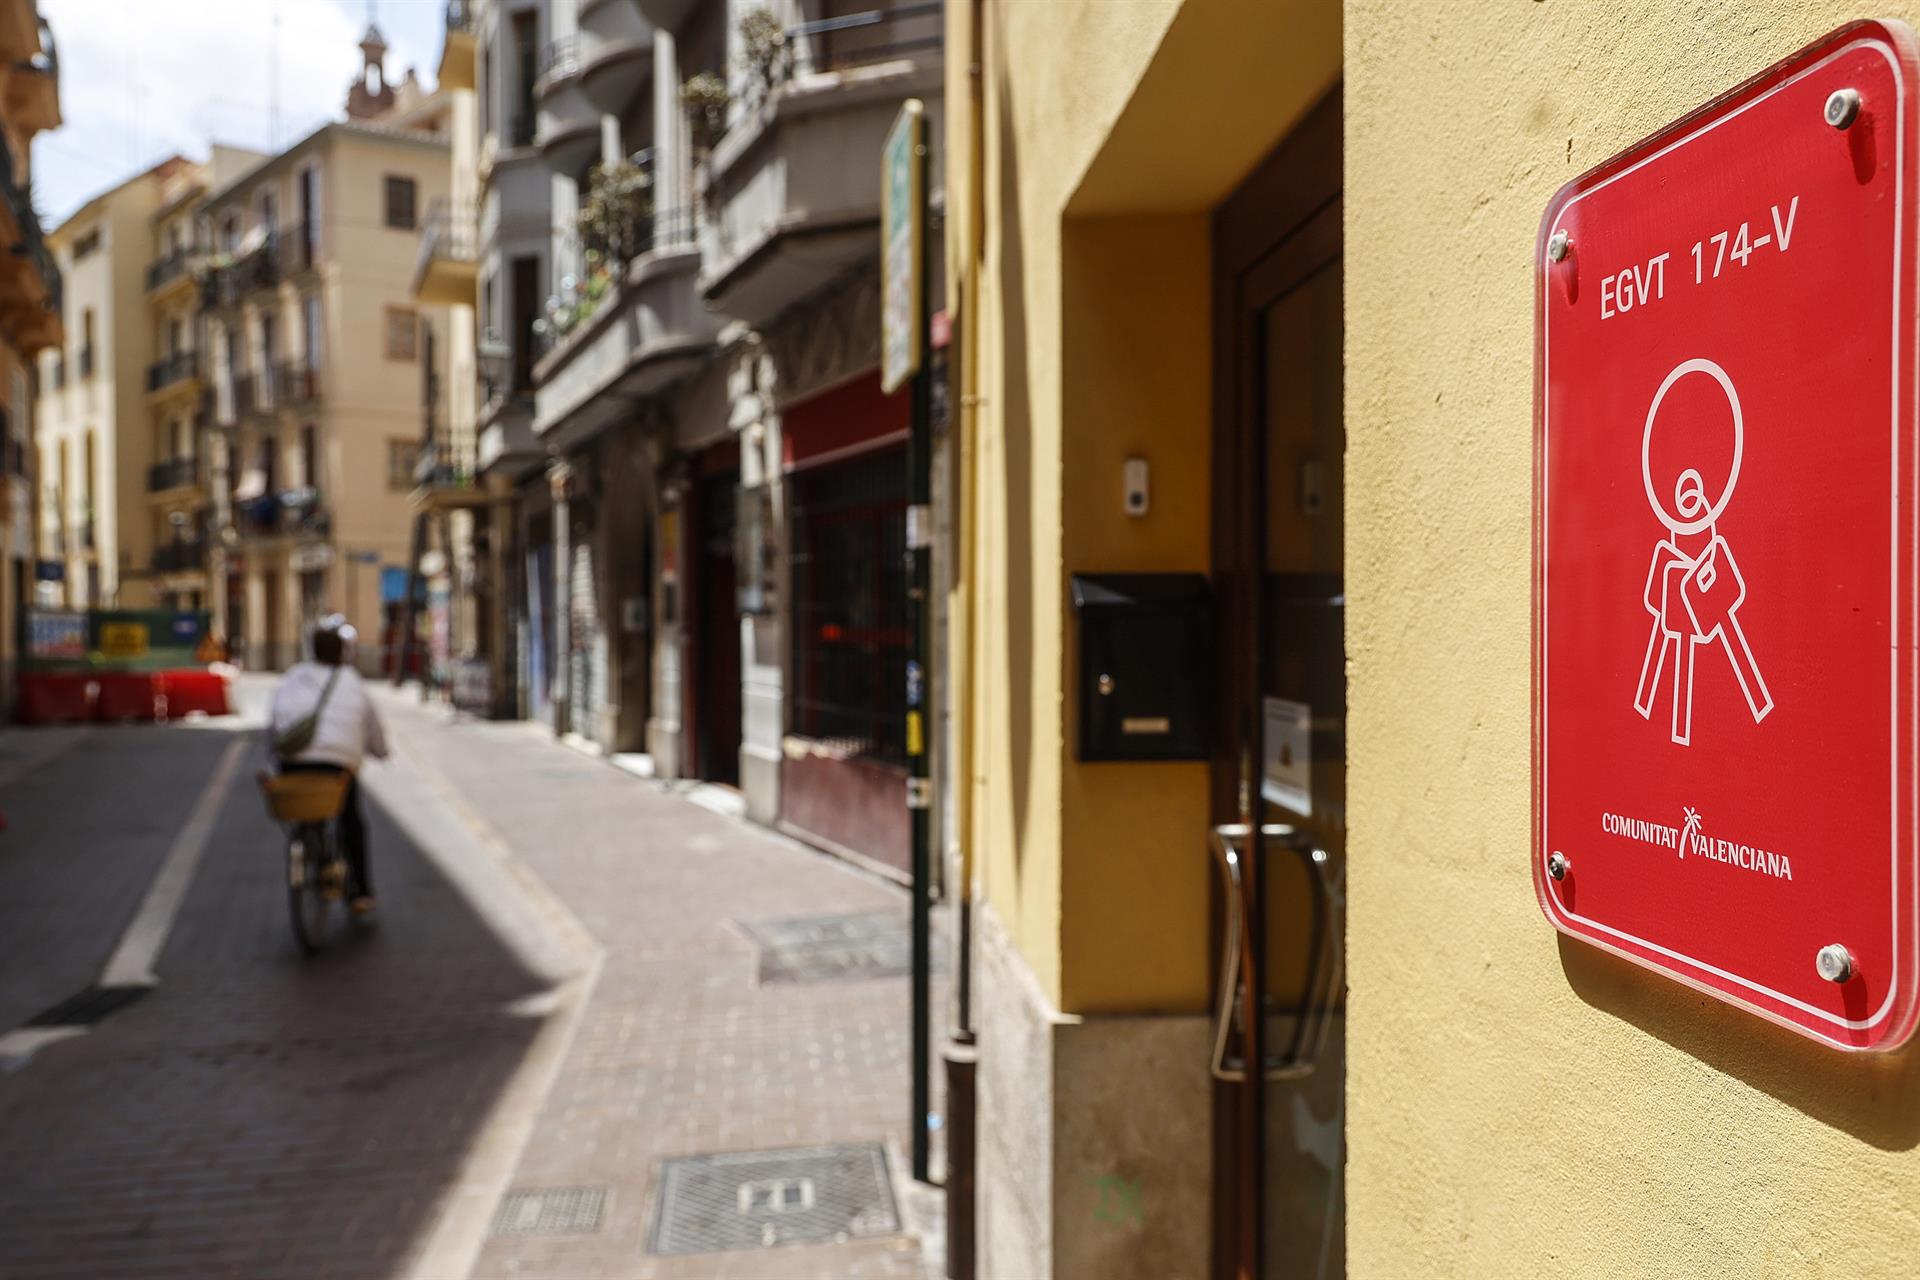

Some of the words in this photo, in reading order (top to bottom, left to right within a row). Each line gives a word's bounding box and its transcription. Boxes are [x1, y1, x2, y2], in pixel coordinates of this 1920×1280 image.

[1601, 252, 1669, 320] EGVT
[1691, 196, 1799, 285] 174-V
[1602, 812, 1679, 849] COMUNITAT
[1690, 832, 1792, 881] VALENCIANA
